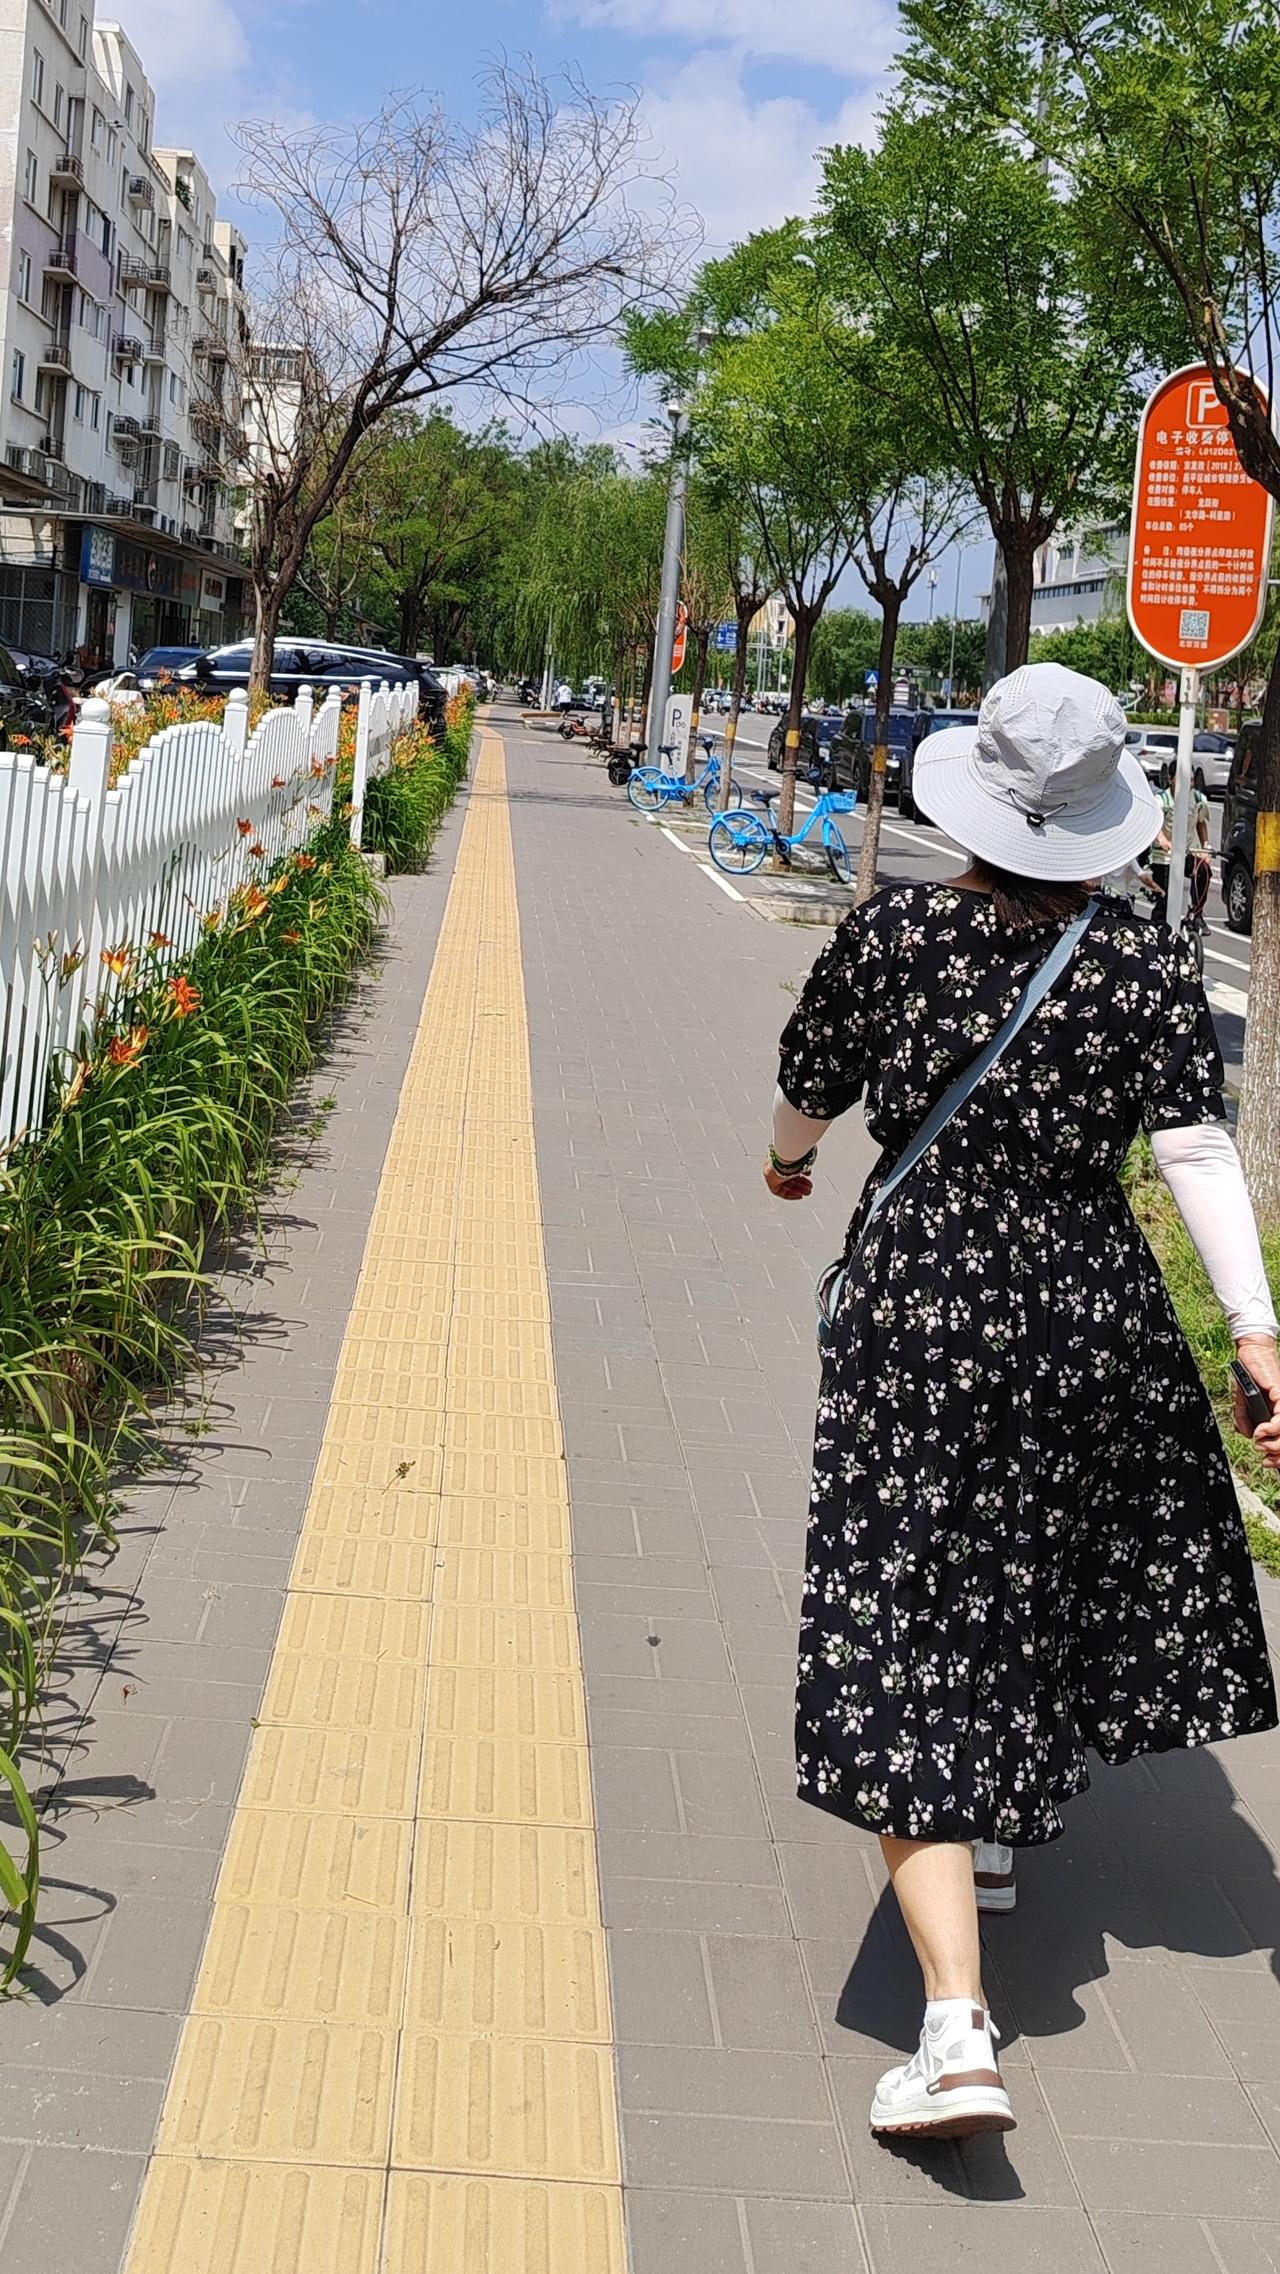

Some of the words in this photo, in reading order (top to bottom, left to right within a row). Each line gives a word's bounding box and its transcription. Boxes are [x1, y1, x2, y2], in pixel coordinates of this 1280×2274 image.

[1197, 388, 1221, 422] P
[1156, 431, 1230, 445] 电子收费停
[672, 708, 682, 727] P
